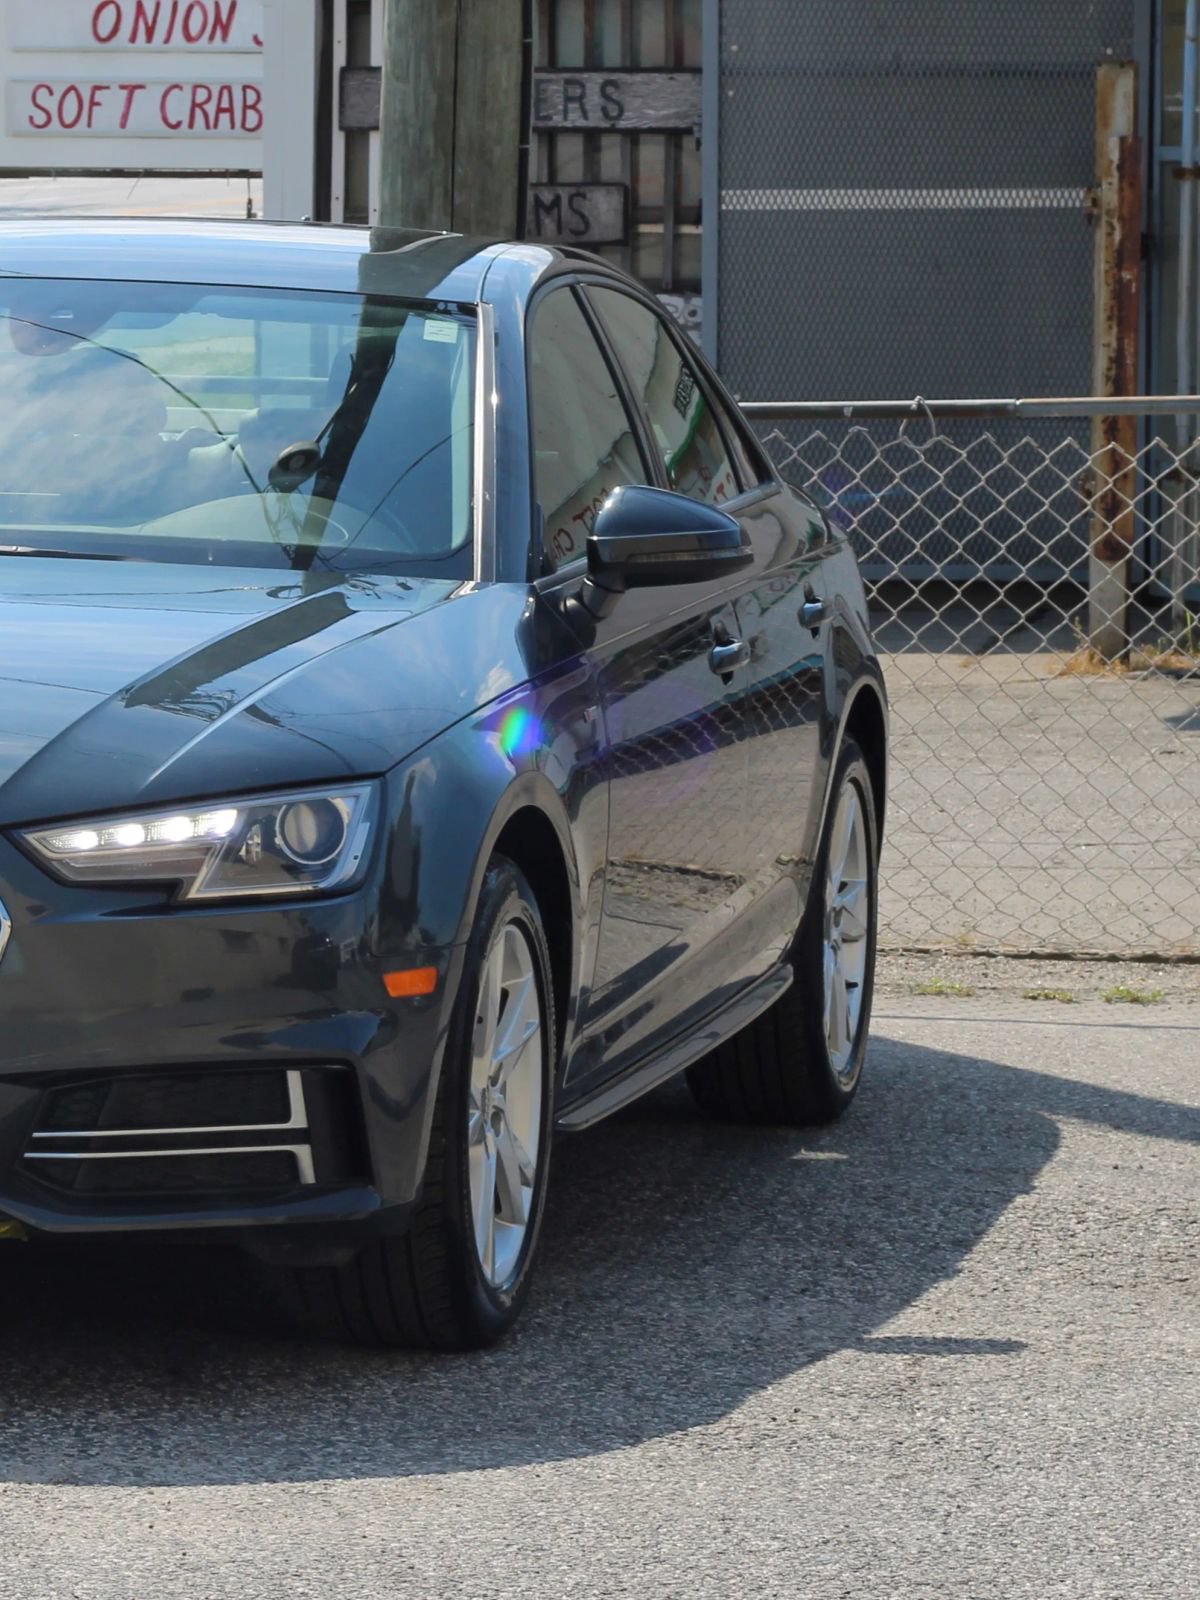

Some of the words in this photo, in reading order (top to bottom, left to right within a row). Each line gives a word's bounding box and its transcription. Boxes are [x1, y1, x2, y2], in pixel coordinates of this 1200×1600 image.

[91, 0, 237, 44] ONION
[28, 83, 146, 129] SOFT
[160, 83, 264, 132] CRAB
[533, 78, 625, 121] ERS
[533, 192, 591, 237] MS
